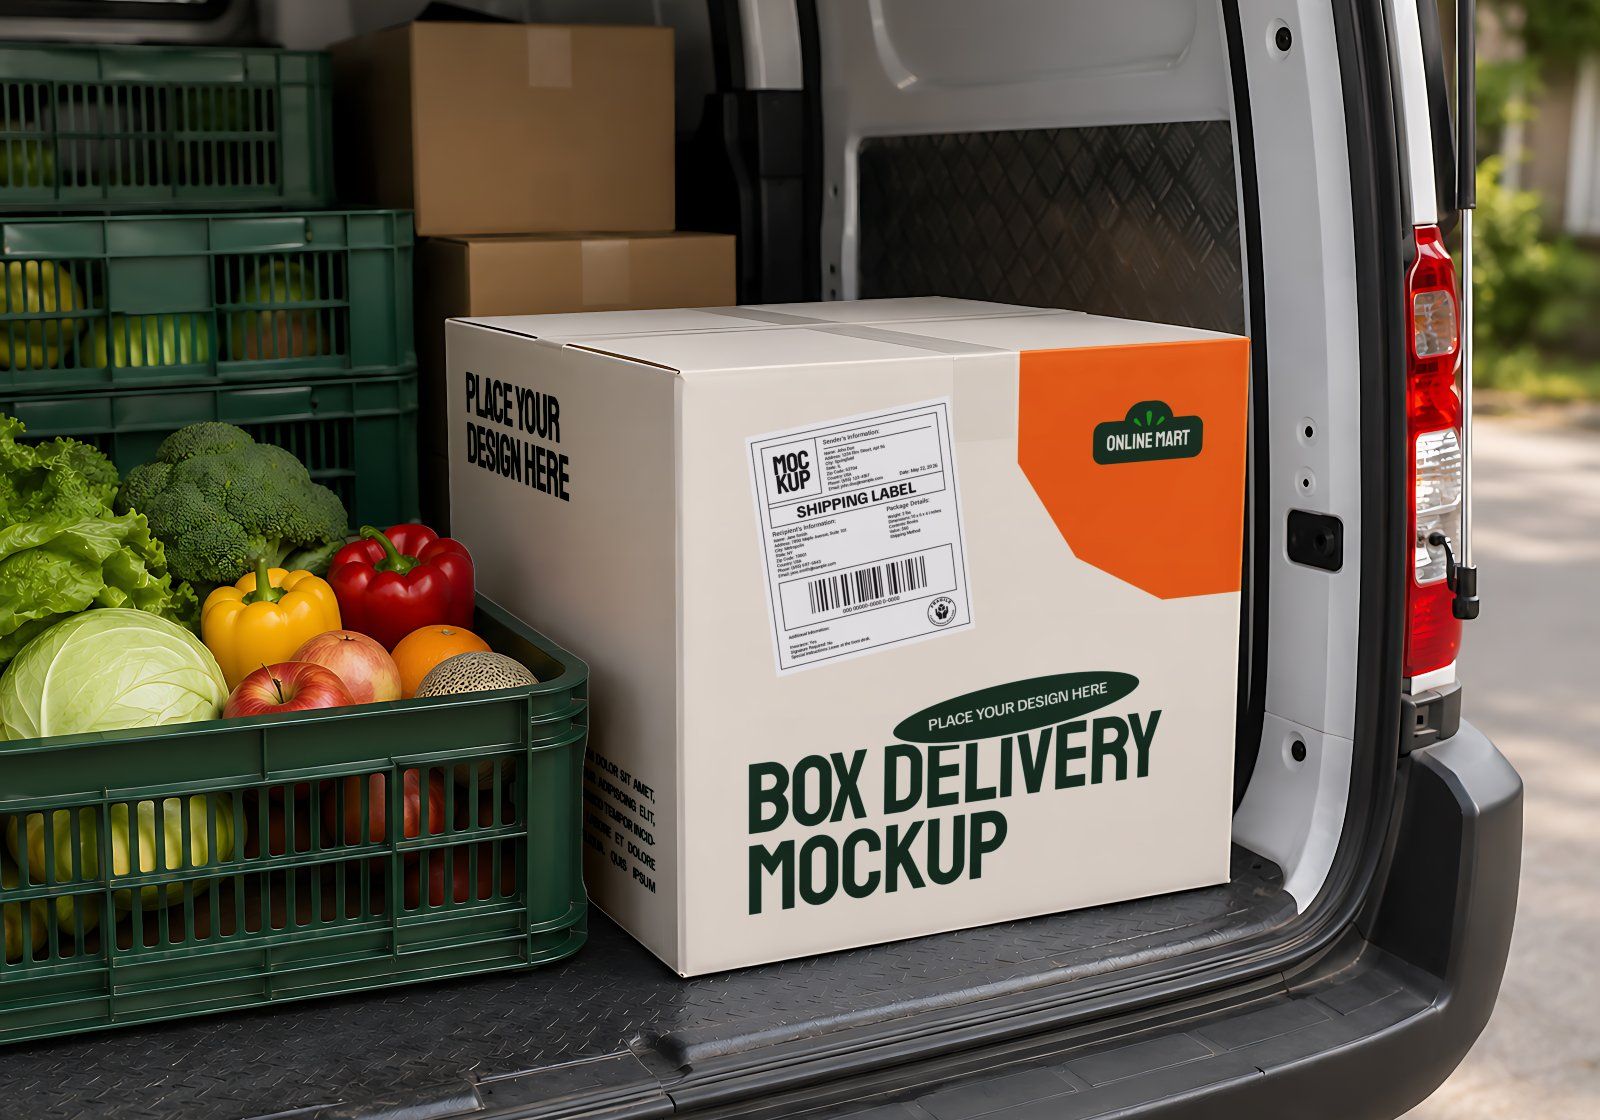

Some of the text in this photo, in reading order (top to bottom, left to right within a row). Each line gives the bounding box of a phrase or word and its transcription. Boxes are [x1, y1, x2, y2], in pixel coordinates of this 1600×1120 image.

[466, 372, 560, 443] PLACE YOUR
[823, 437, 846, 445] Sender's
[1107, 429, 1191, 452] ONLINE MART
[467, 422, 570, 502] DESIGN HERE
[772, 450, 810, 476] MOC
[775, 470, 811, 494] KUP
[797, 482, 917, 519] SHIPPING LABEL
[887, 503, 909, 512] Package
[772, 527, 803, 538] Recipient's
[928, 682, 1108, 732] PLACE YOUR DESIGN HERE
[595, 753, 619, 779] DOLOR
[620, 770, 632, 786] SIT
[633, 779, 656, 804] AMET,
[749, 709, 1163, 835] BOX DELIVERY
[598, 777, 637, 813] ADIPISCING
[639, 804, 656, 827] ELIT,
[604, 802, 633, 833] TEMPOR
[615, 833, 625, 848] ET
[628, 841, 656, 872] DOLORE
[749, 810, 1008, 915] MOCKUP
[611, 851, 627, 872] QUIS
[632, 867, 656, 894] IPSUM
